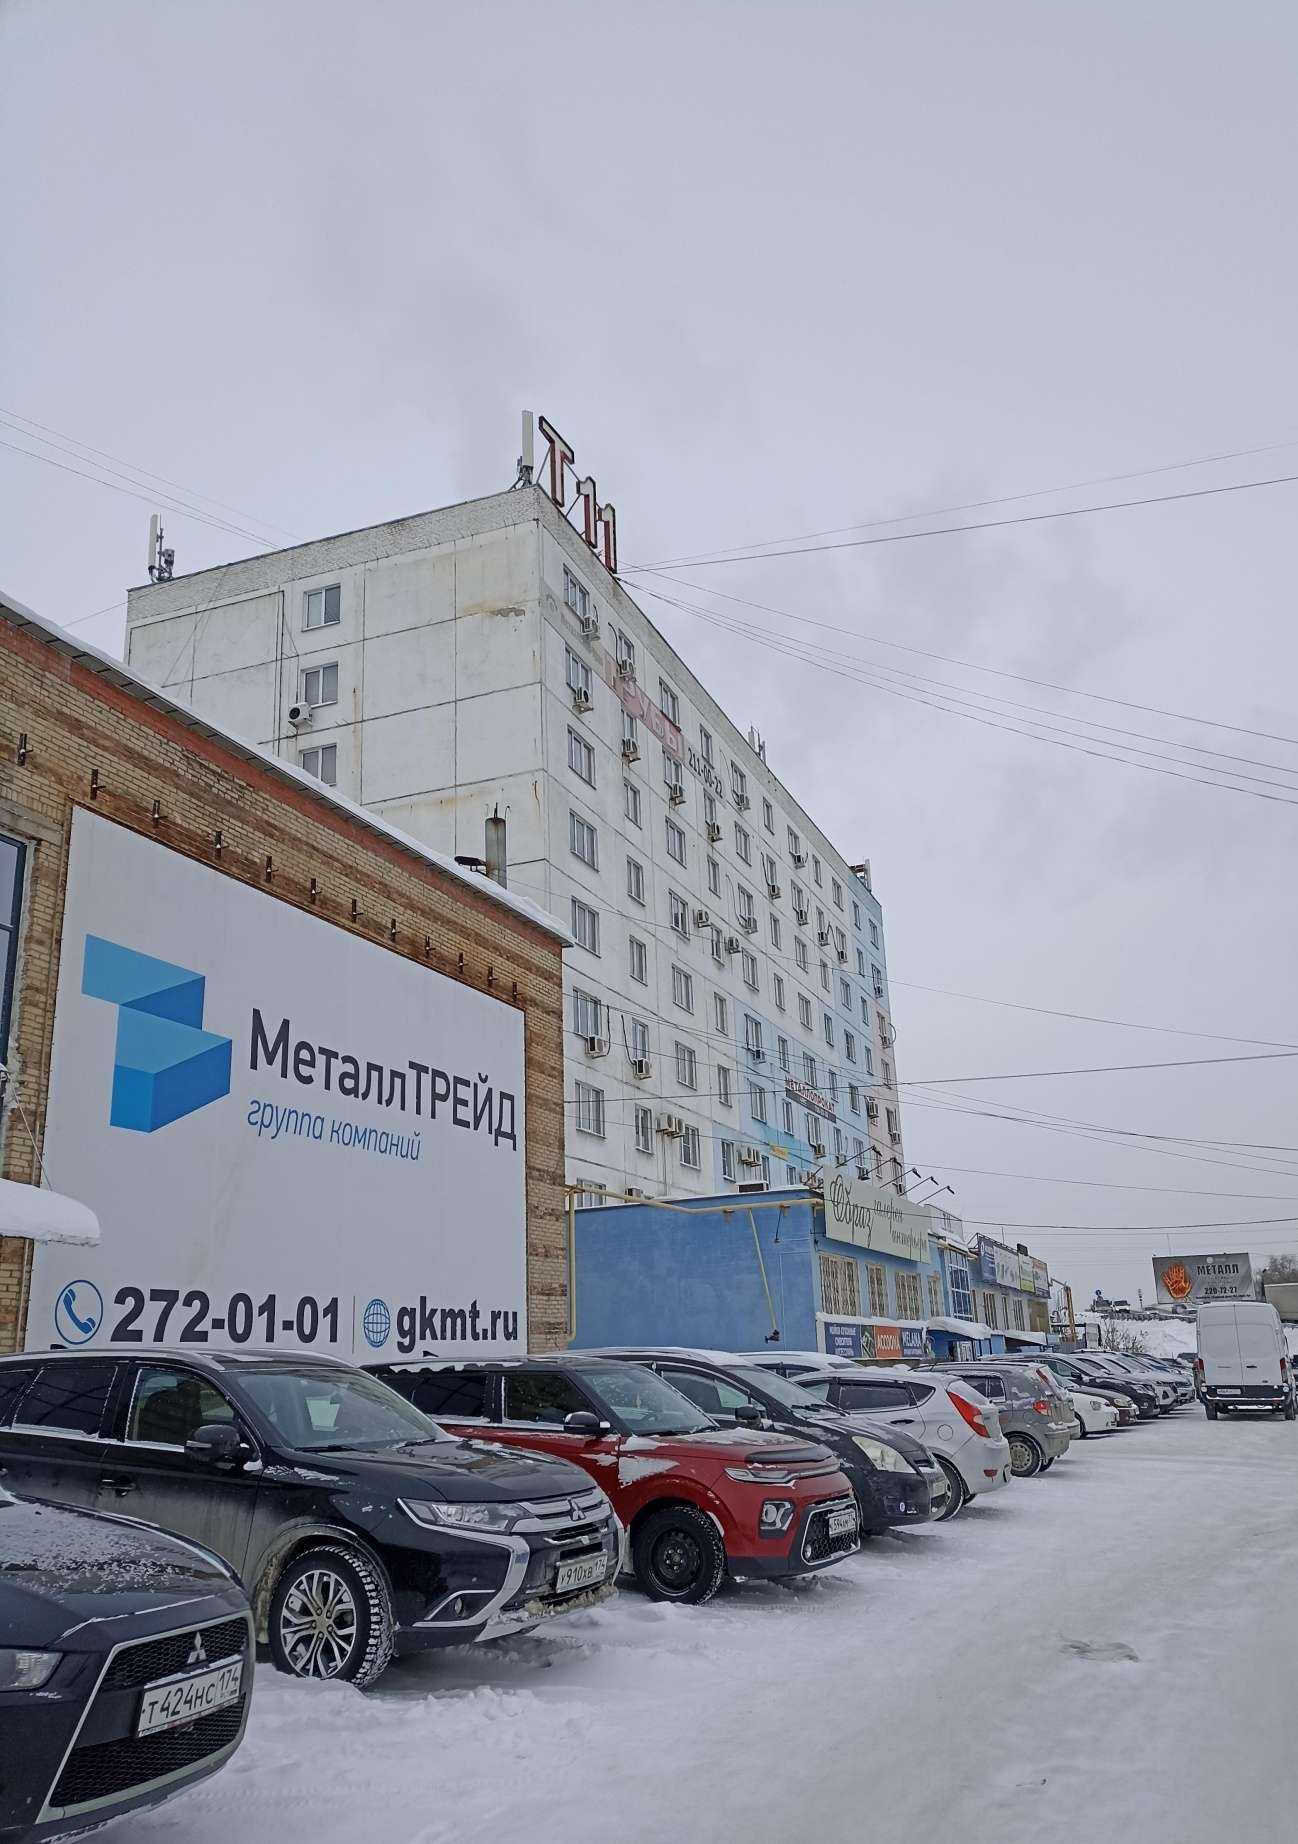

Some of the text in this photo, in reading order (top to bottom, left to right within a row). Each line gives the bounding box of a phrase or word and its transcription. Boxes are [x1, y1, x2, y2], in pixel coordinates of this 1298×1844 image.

[688, 747, 723, 799] 211-00-22
[250, 1008, 517, 1151] МеталлТРЕЙД
[247, 1100, 422, 1161] группа компаний
[830, 1175, 874, 1249] Образ
[1196, 1263, 1239, 1275] МЕТАЛЛ
[110, 1287, 340, 1343] 272-01-01
[396, 1296, 518, 1354] gkmt.ru
[148, 1666, 239, 1724] Т424НС 174
